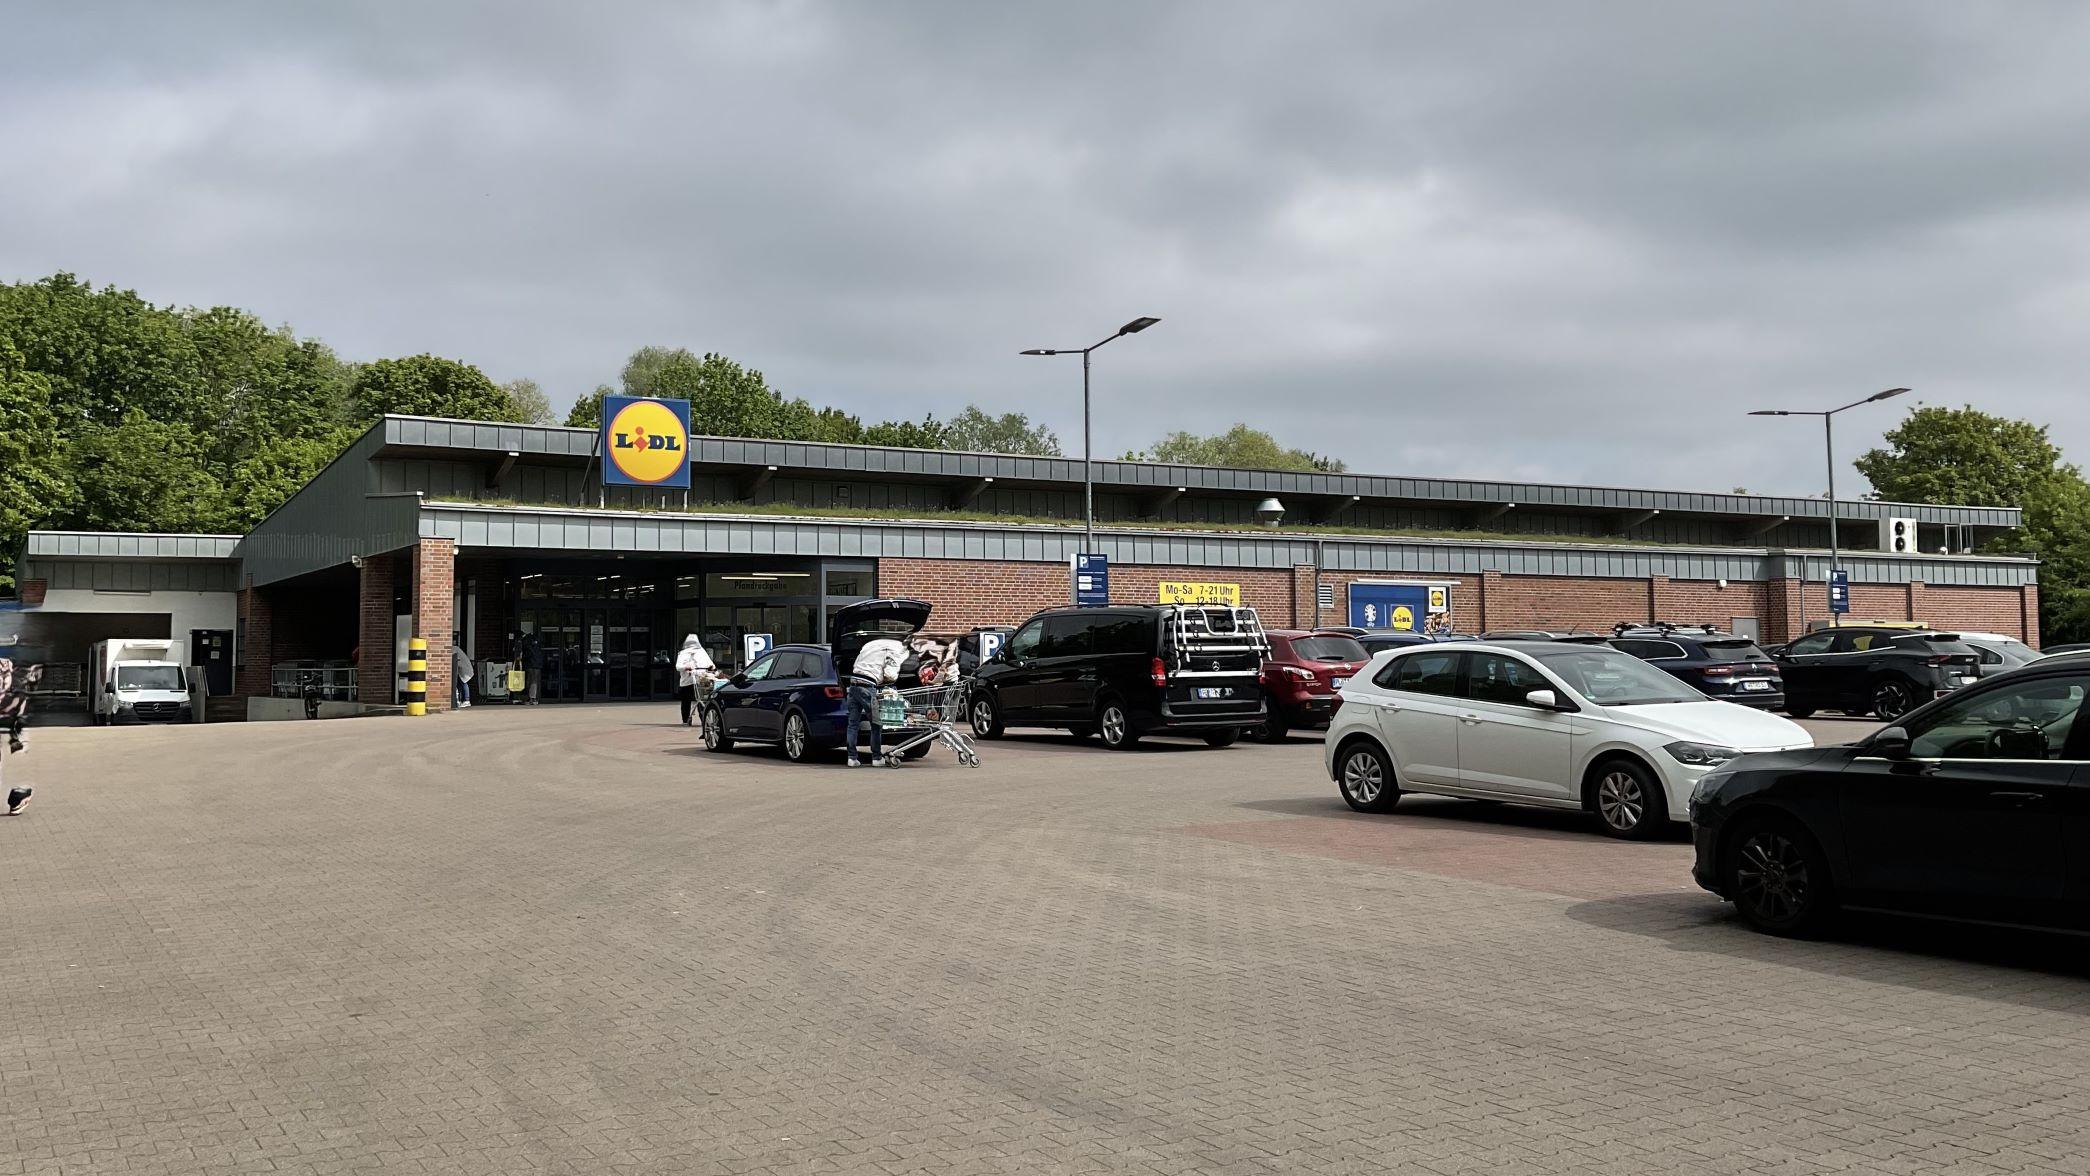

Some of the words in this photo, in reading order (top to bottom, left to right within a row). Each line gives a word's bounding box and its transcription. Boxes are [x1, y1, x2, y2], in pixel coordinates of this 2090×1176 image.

[1165, 584, 1193, 595] Mo-Sa
[1219, 586, 1233, 595] Uhr
[1174, 595, 1185, 604] So
[1219, 597, 1233, 605] Uhr
[747, 636, 766, 660] P
[983, 634, 1000, 657] P
